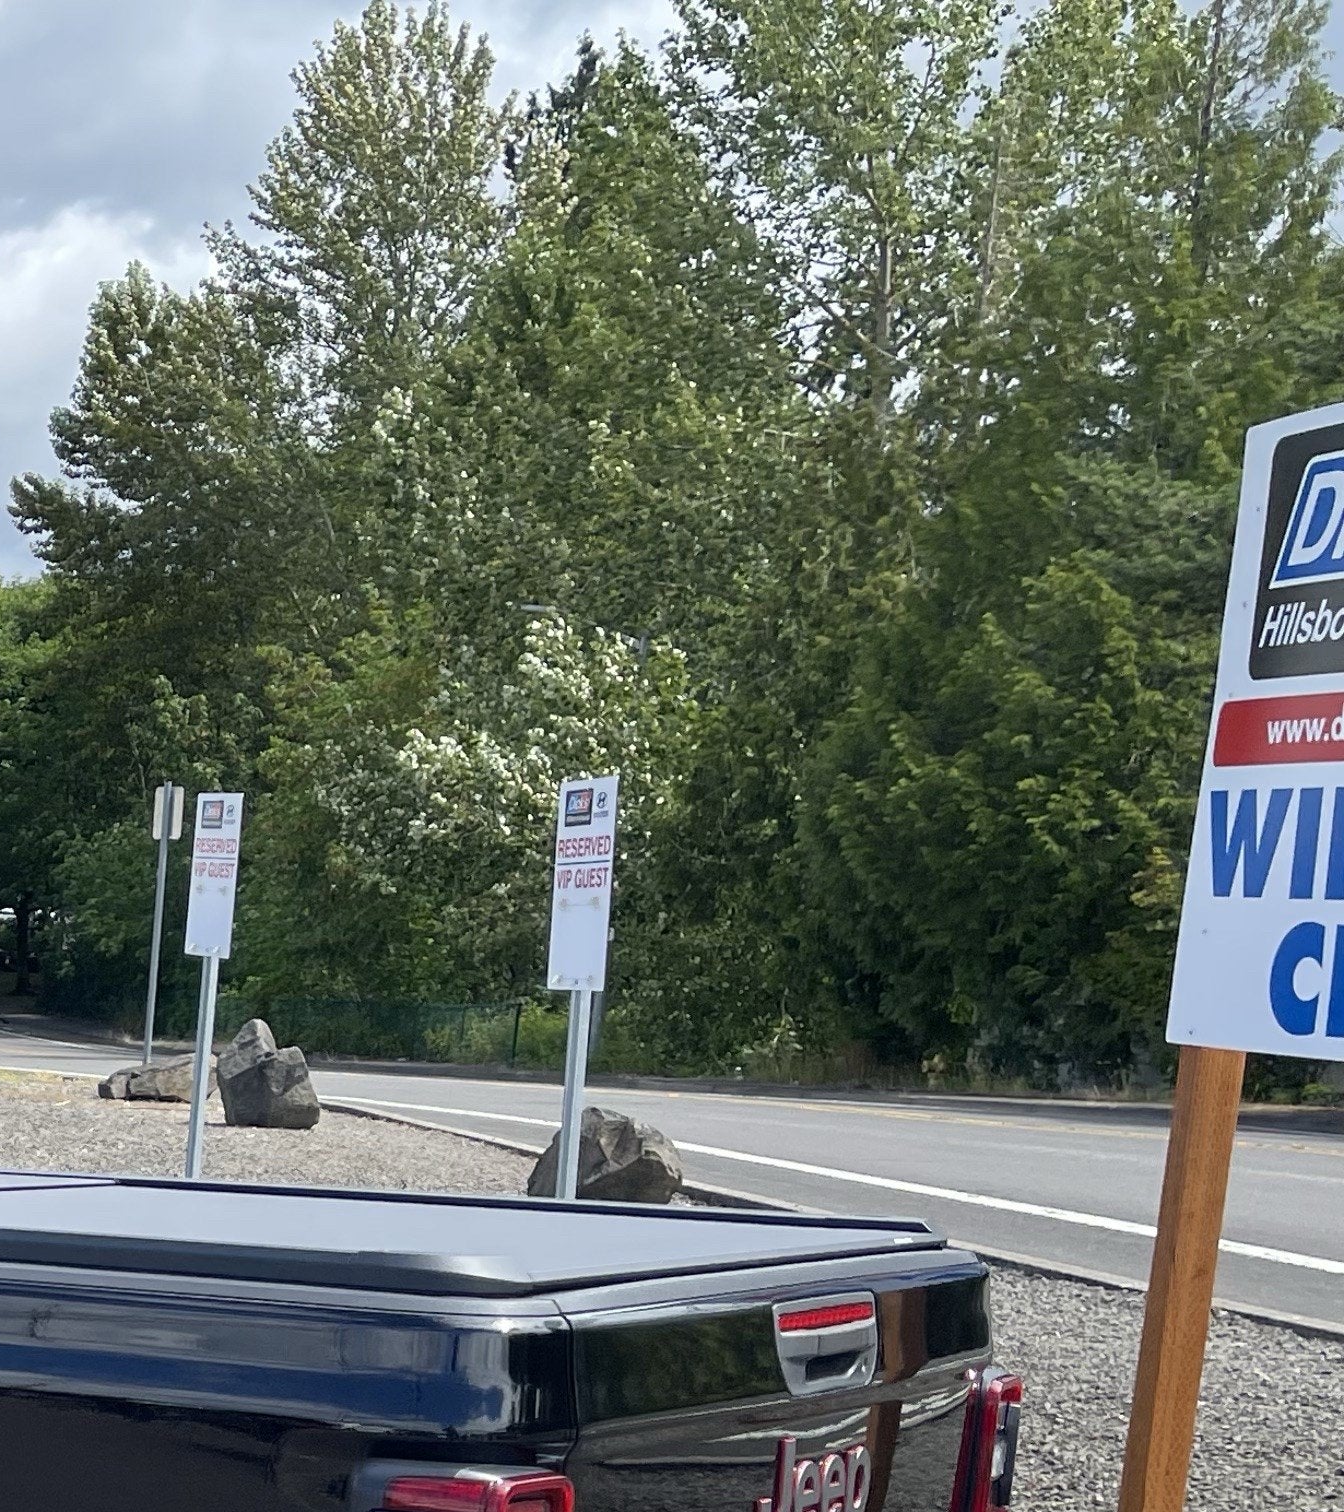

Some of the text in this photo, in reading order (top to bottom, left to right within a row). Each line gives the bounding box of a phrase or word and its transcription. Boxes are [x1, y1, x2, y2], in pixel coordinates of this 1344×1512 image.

[558, 835, 611, 858] RESERVED
[557, 867, 609, 889] VIP GUEST
